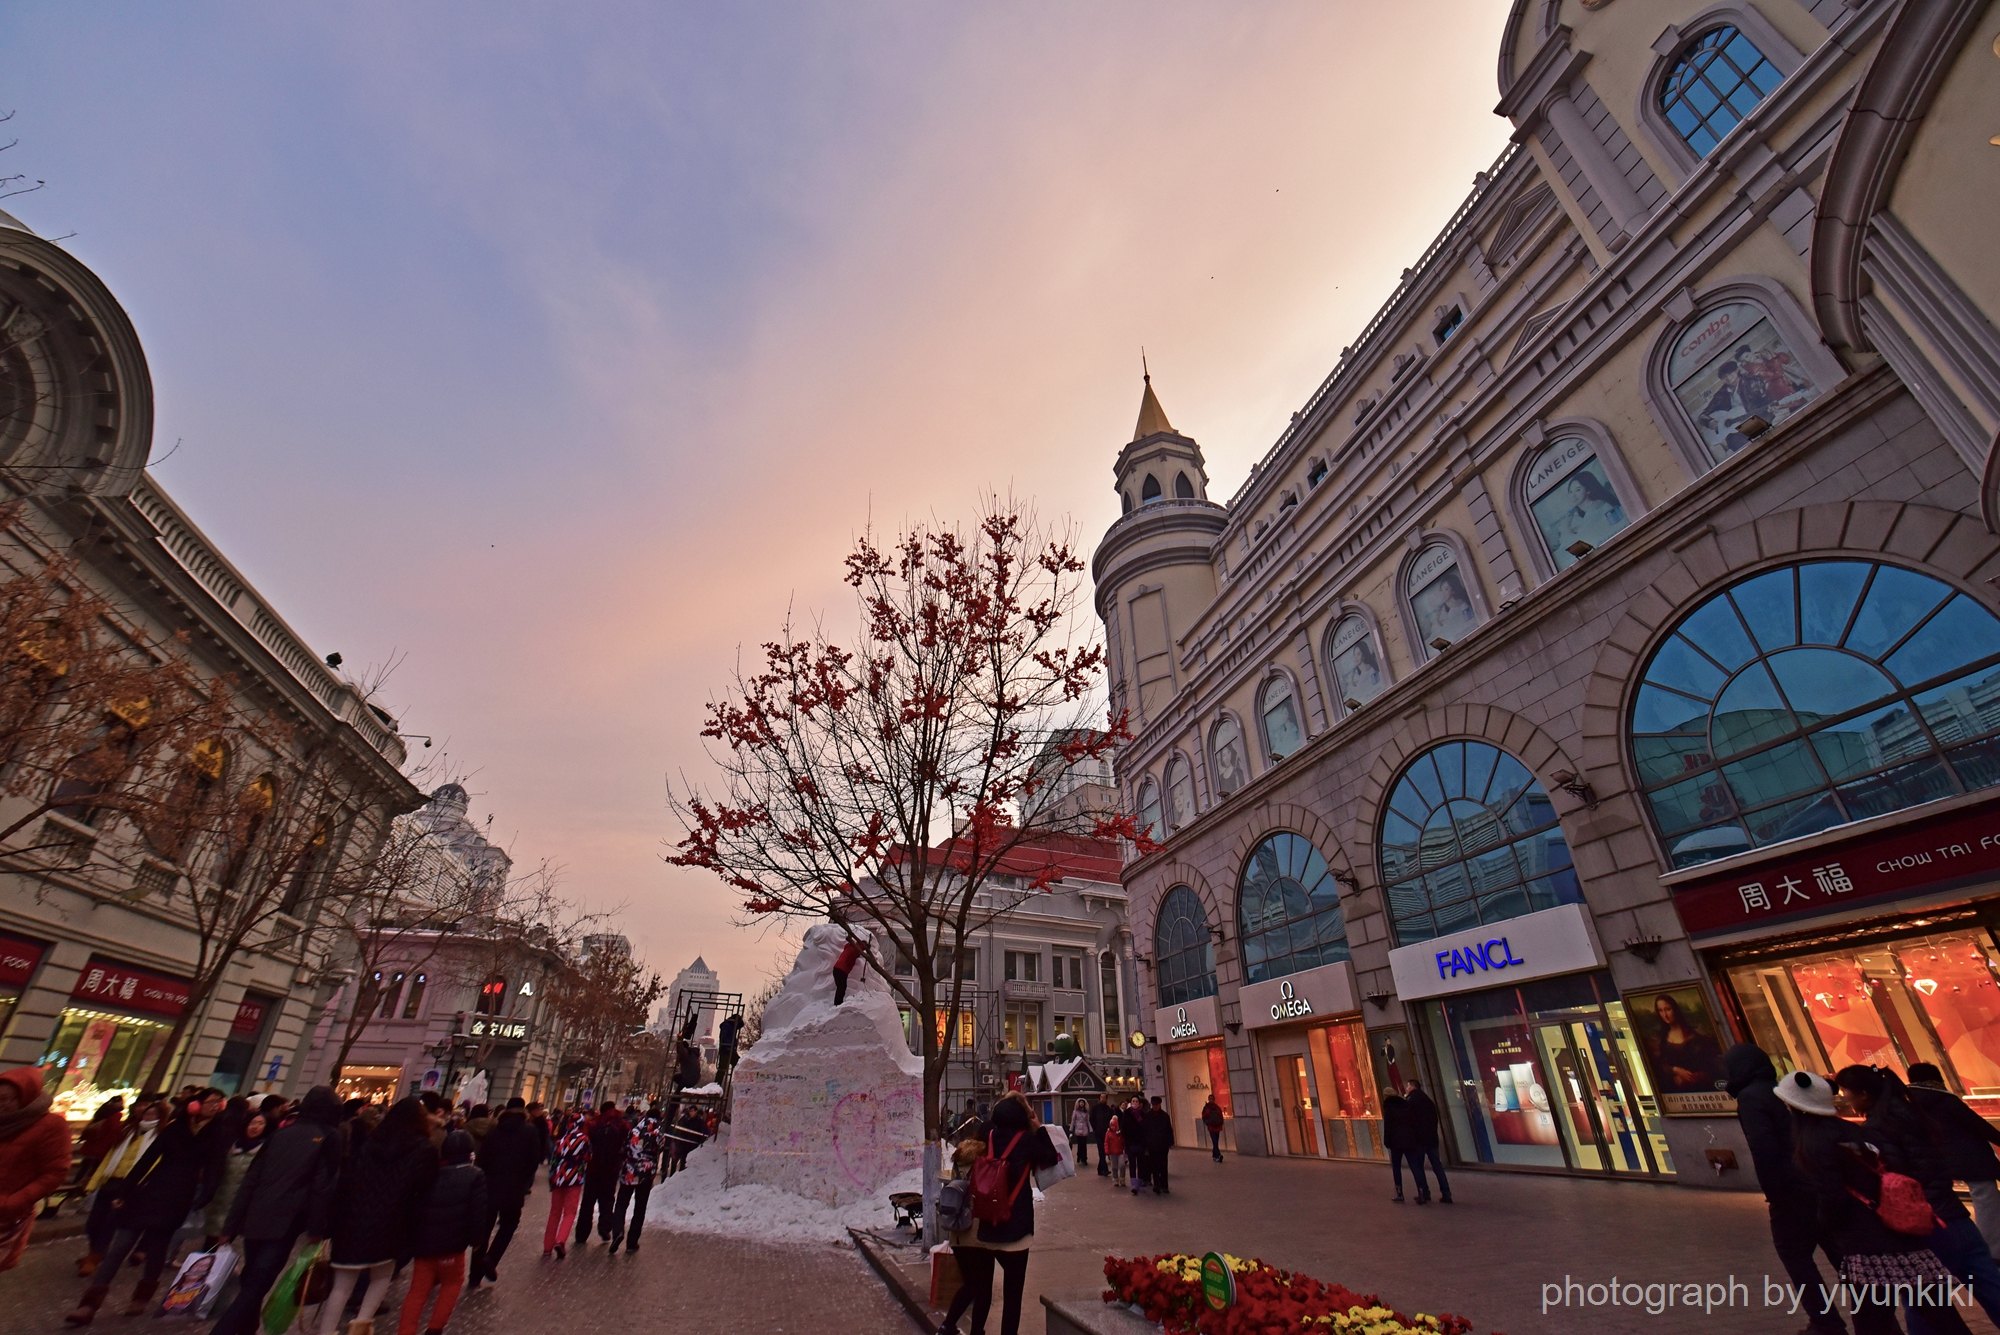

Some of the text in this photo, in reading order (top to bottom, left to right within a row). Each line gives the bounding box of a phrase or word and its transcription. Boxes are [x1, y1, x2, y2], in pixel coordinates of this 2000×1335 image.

[1681, 313, 1730, 358] combo
[1528, 440, 1586, 489] LANEIGE
[1410, 550, 1450, 587] LANEIGE
[1333, 619, 1366, 650] LANEIGE
[1738, 862, 1854, 914] 周大福
[1876, 851, 1933, 873] CHOW
[1935, 842, 1972, 860] TAI
[1435, 937, 1524, 980] FANCL
[81, 968, 139, 1000] 周大福
[1270, 998, 1312, 1020] OMEGA
[1170, 1022, 1198, 1039] OMEGA
